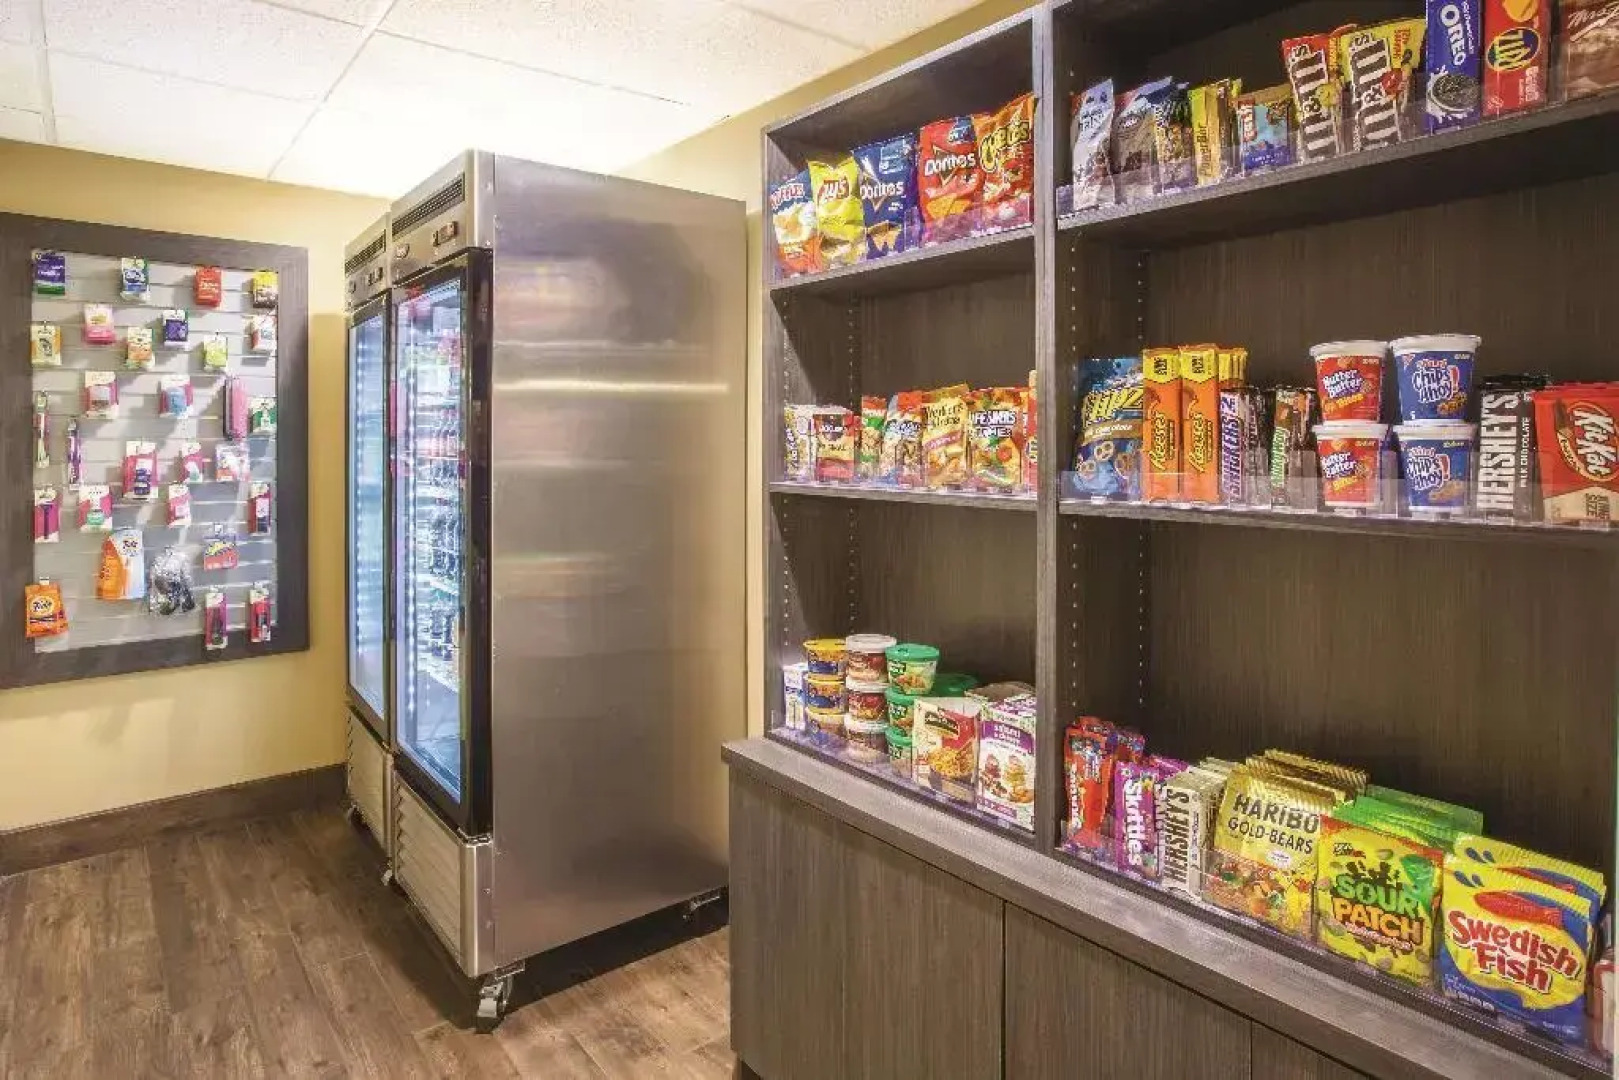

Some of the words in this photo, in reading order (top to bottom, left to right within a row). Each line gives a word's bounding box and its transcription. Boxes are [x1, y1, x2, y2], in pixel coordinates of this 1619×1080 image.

[1440, 4, 1467, 66] OREO
[924, 152, 976, 177] Doritos
[860, 180, 905, 201] Doritos
[1221, 416, 1241, 496] SNICKERS
[1477, 391, 1520, 510] HERSHEY'S
[1521, 416, 1530, 465] CHOCOLATE
[1123, 779, 1143, 866] Skittles
[1164, 787, 1190, 884] HERSHEY'S
[1228, 816, 1313, 855] GOLD-BEARS
[1232, 792, 1319, 835] HARIBO
[1334, 898, 1424, 943] PATCH
[1336, 873, 1419, 921] SOUR
[1447, 910, 1582, 979] Swedish
[1473, 942, 1552, 994] Fish
